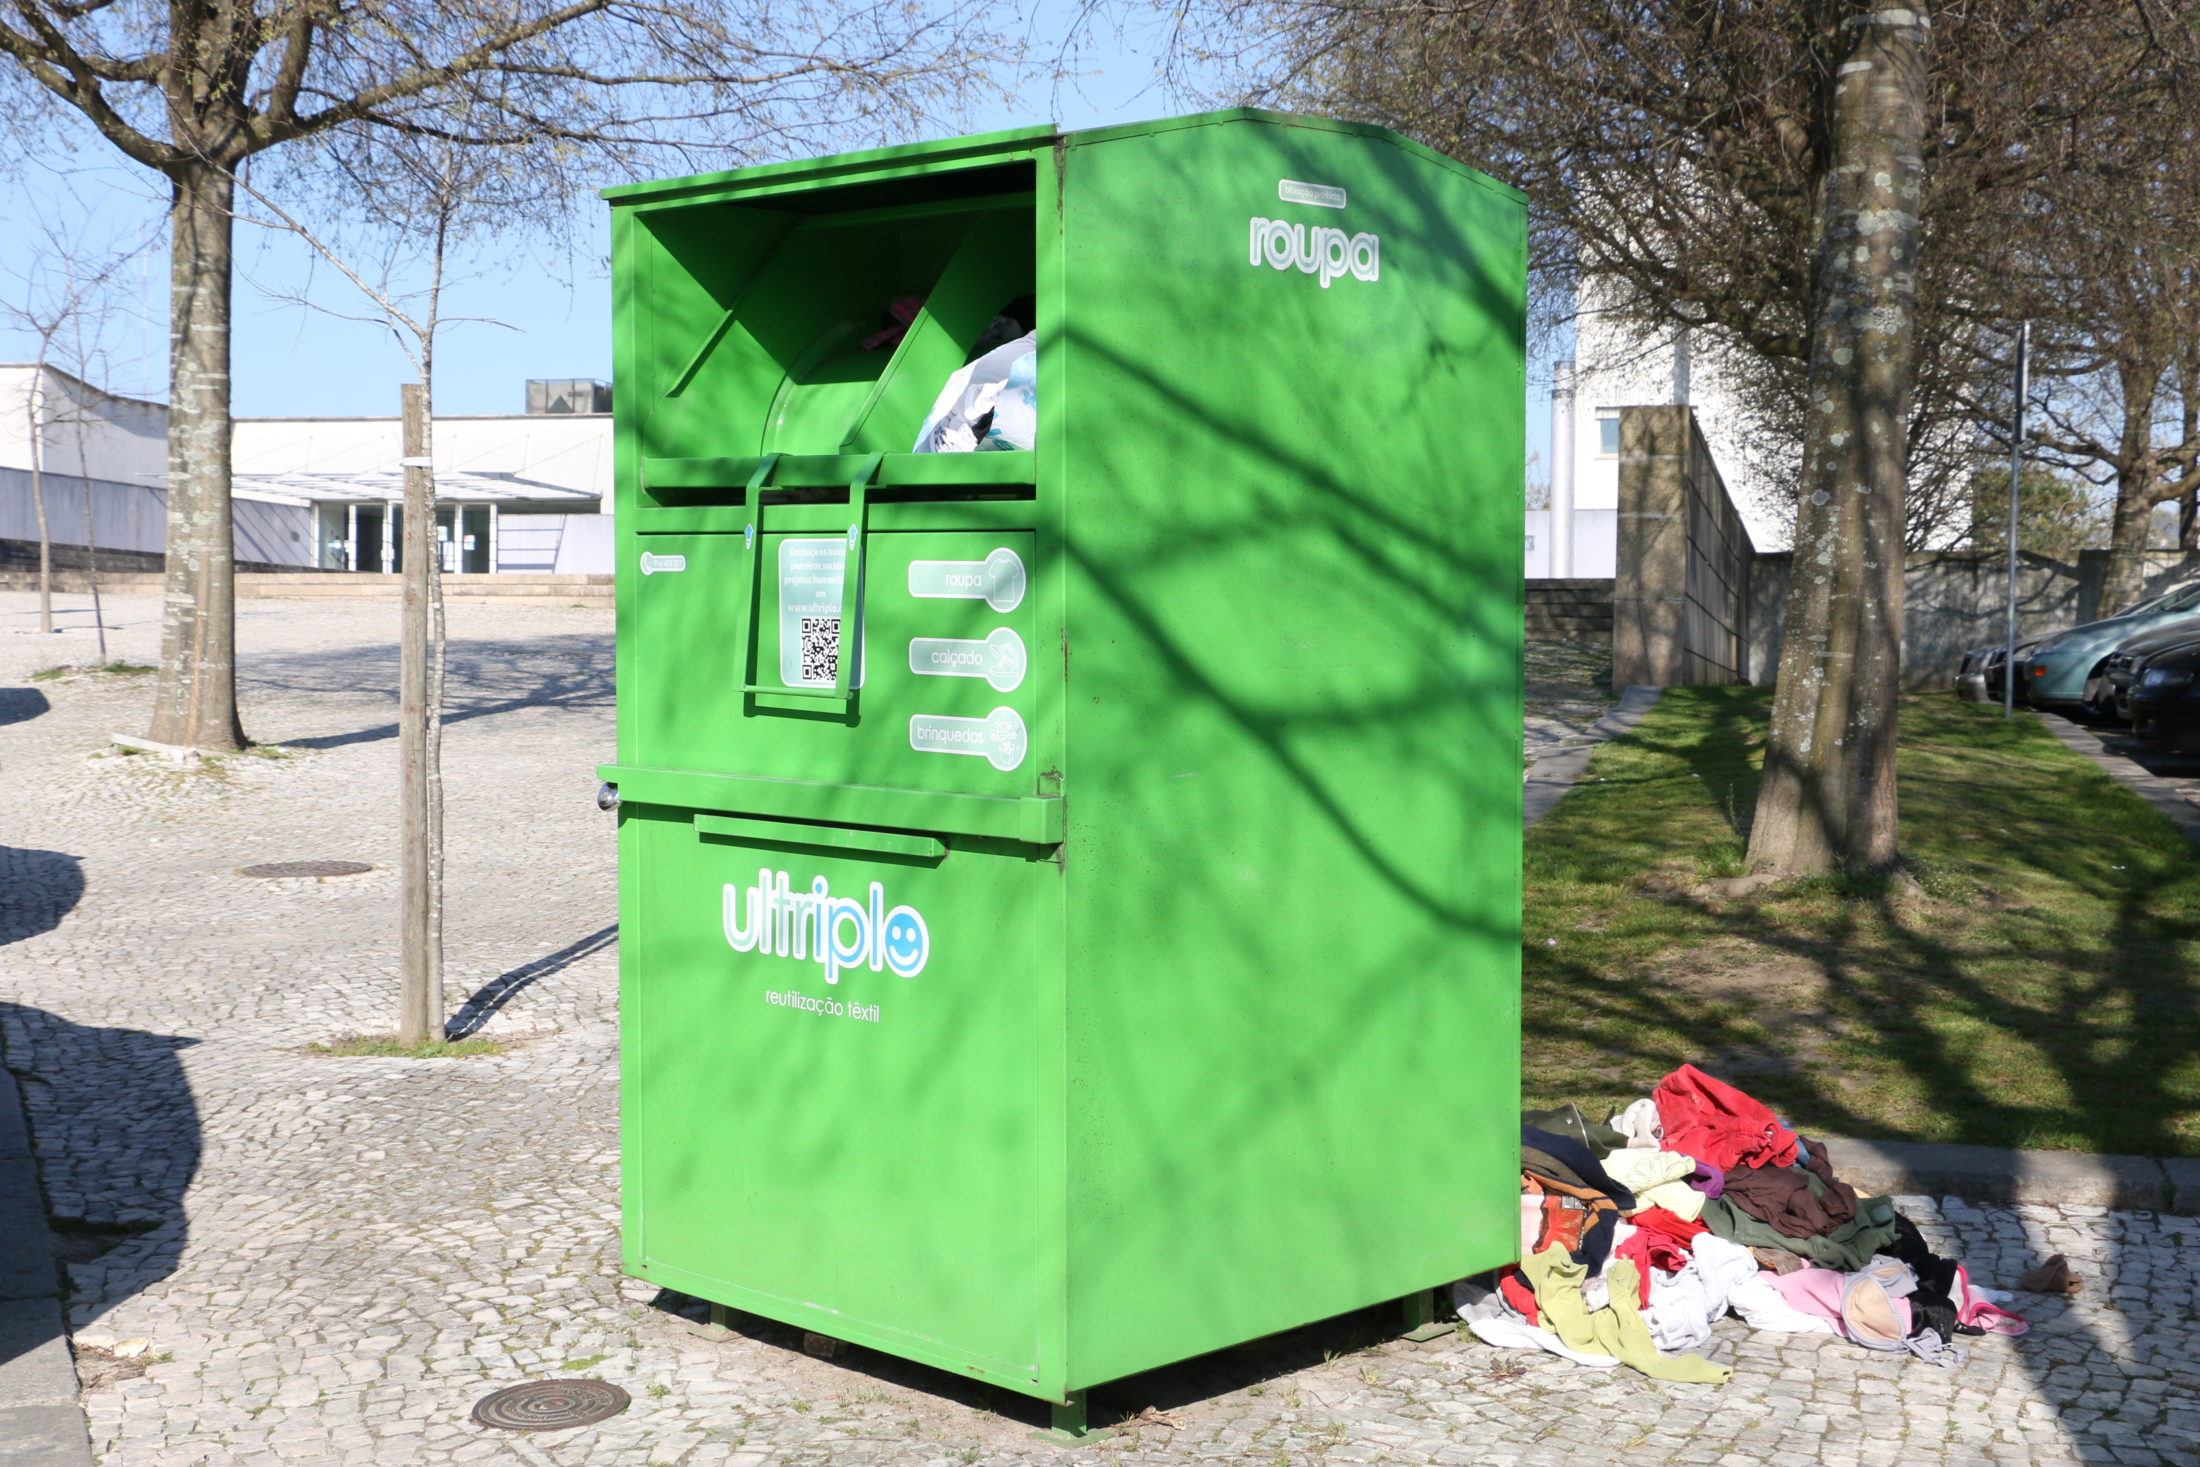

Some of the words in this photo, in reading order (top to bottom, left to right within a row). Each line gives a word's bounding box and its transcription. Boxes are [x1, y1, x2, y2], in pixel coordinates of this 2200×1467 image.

[1249, 216, 1379, 289] roupa
[789, 547, 818, 558] Conheça
[819, 548, 828, 557] os
[828, 548, 846, 557] noss
[790, 561, 821, 572] parceiros
[783, 575, 812, 586] projetos
[945, 574, 982, 589] roupa
[931, 649, 983, 668] calçado
[917, 724, 984, 744] brinquedos
[722, 868, 930, 985] ultriplo
[765, 989, 844, 1017] reutilização
[848, 1000, 880, 1022] têxtil
